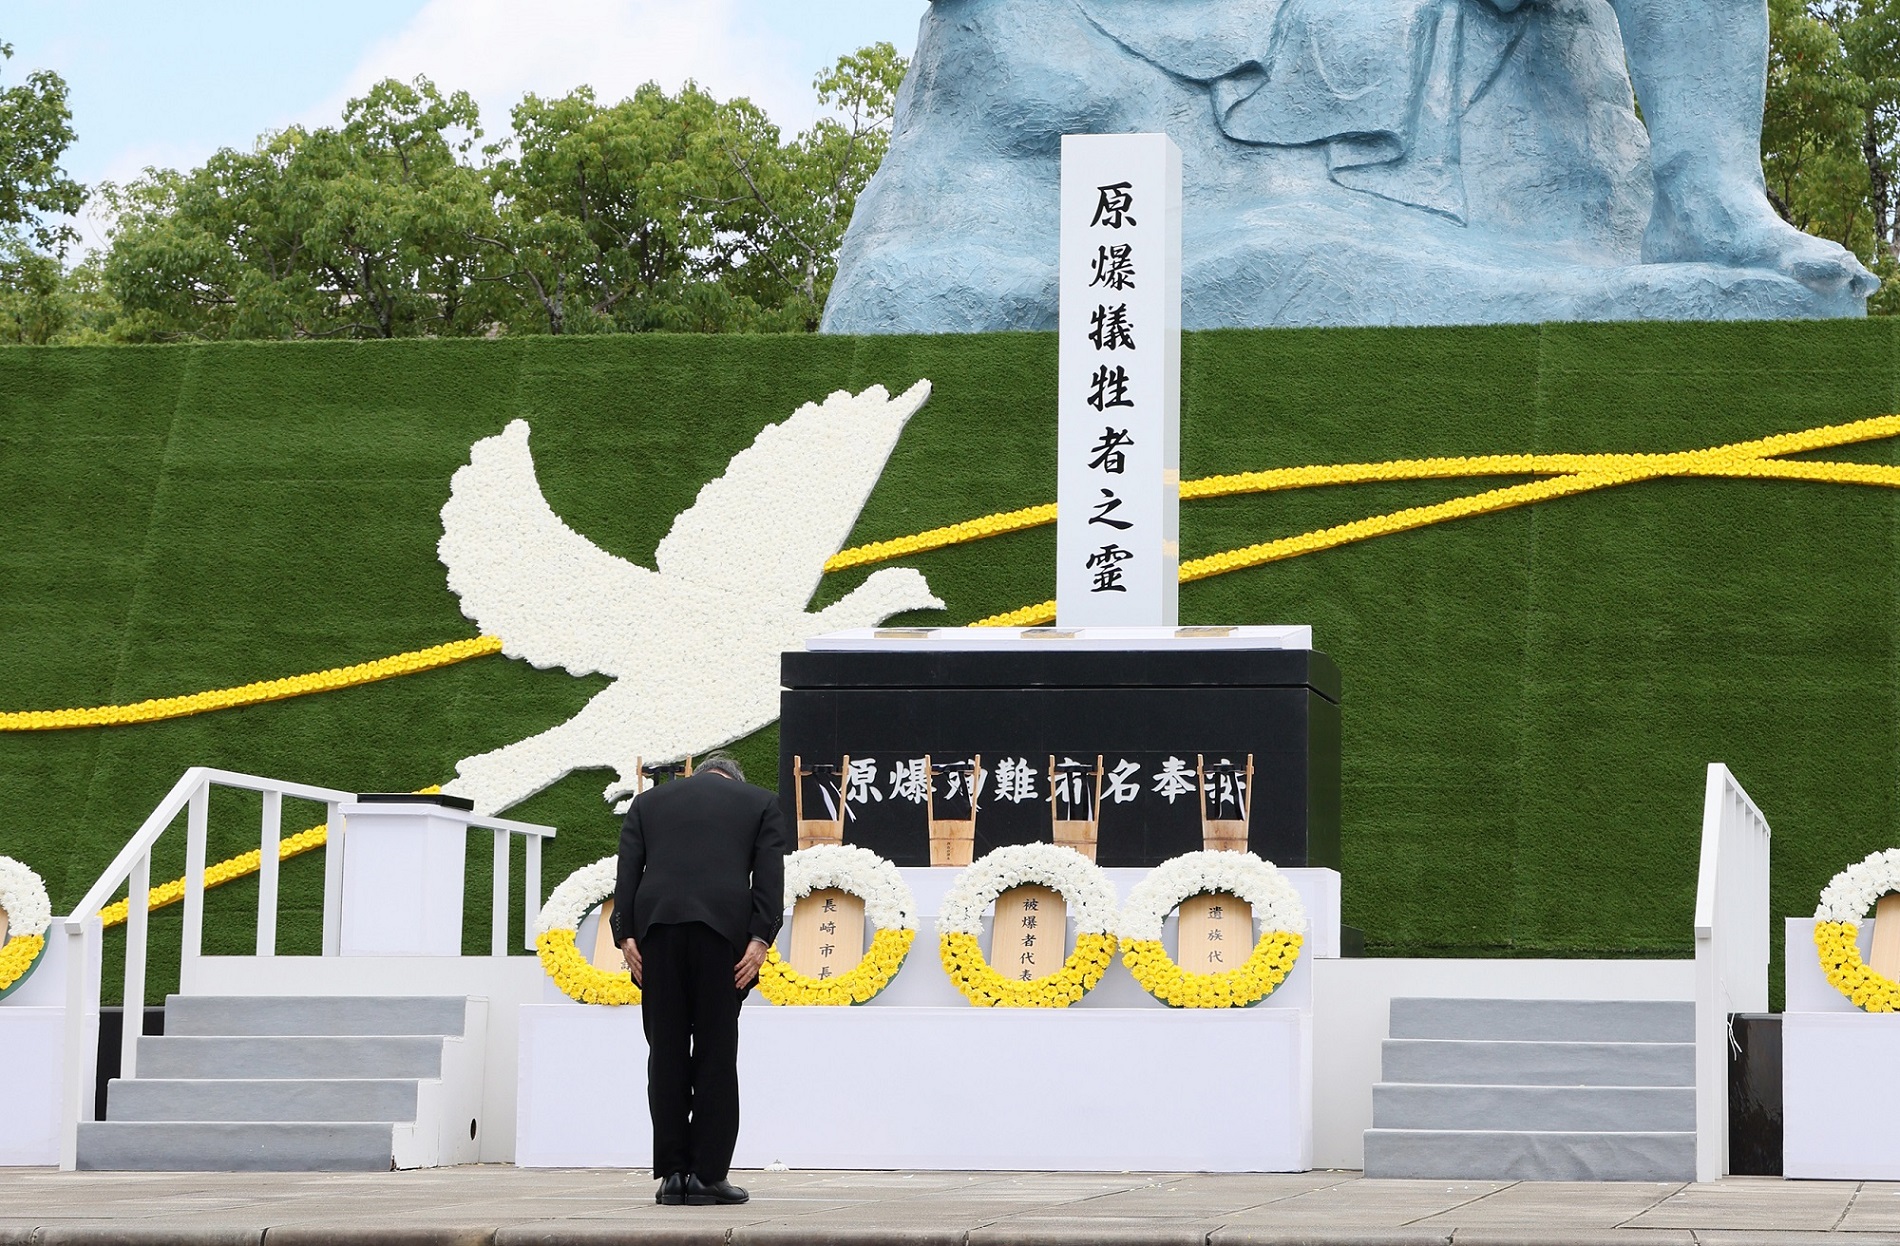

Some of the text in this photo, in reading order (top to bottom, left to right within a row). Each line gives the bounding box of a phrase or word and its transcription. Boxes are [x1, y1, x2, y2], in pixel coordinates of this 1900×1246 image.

[818, 898, 837, 980] 長崎市長
[1019, 898, 1039, 981] 被爆者代表
[1207, 905, 1224, 974] 遺族代
